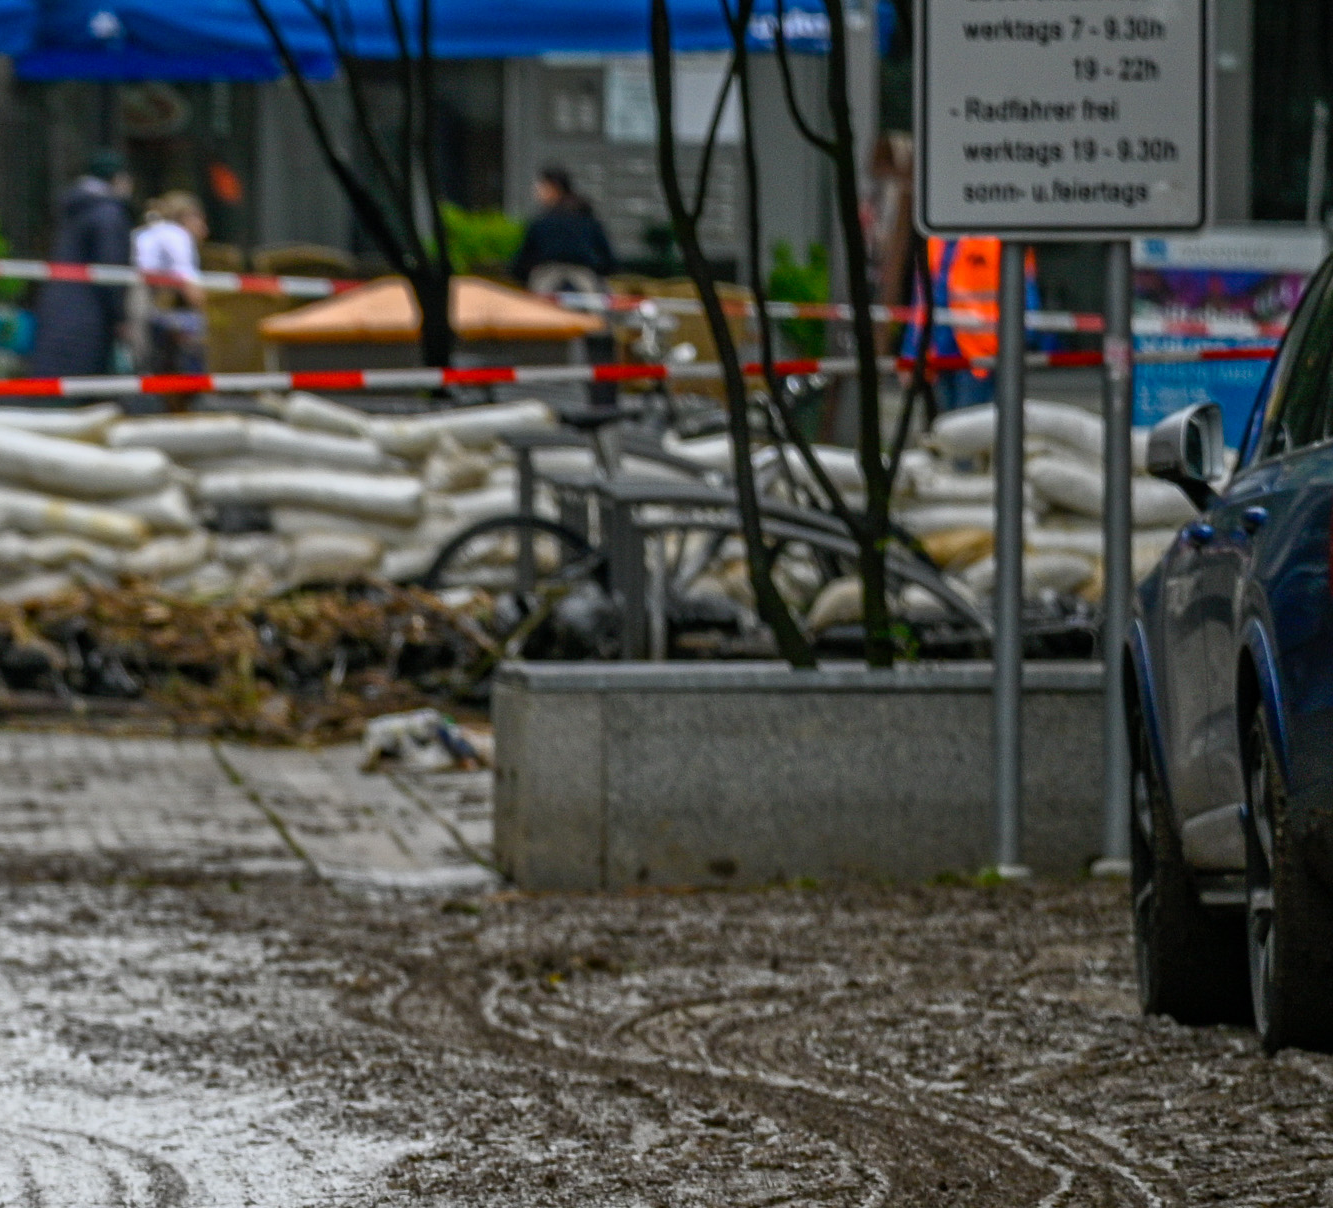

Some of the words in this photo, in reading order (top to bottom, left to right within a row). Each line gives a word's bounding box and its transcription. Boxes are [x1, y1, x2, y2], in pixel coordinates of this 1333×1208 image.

[963, 17, 1063, 45] werktags
[1070, 15, 1083, 40] 7
[1104, 15, 1166, 41] 9.30h
[1073, 56, 1099, 81] 19
[1119, 56, 1161, 81] 22h
[964, 96, 1075, 122] Radfahrer
[1082, 96, 1120, 122] frei
[963, 139, 1063, 167] werktags
[1073, 137, 1098, 163] 19
[1117, 137, 1179, 163] 9.30h
[963, 183, 1026, 204] sonn-
